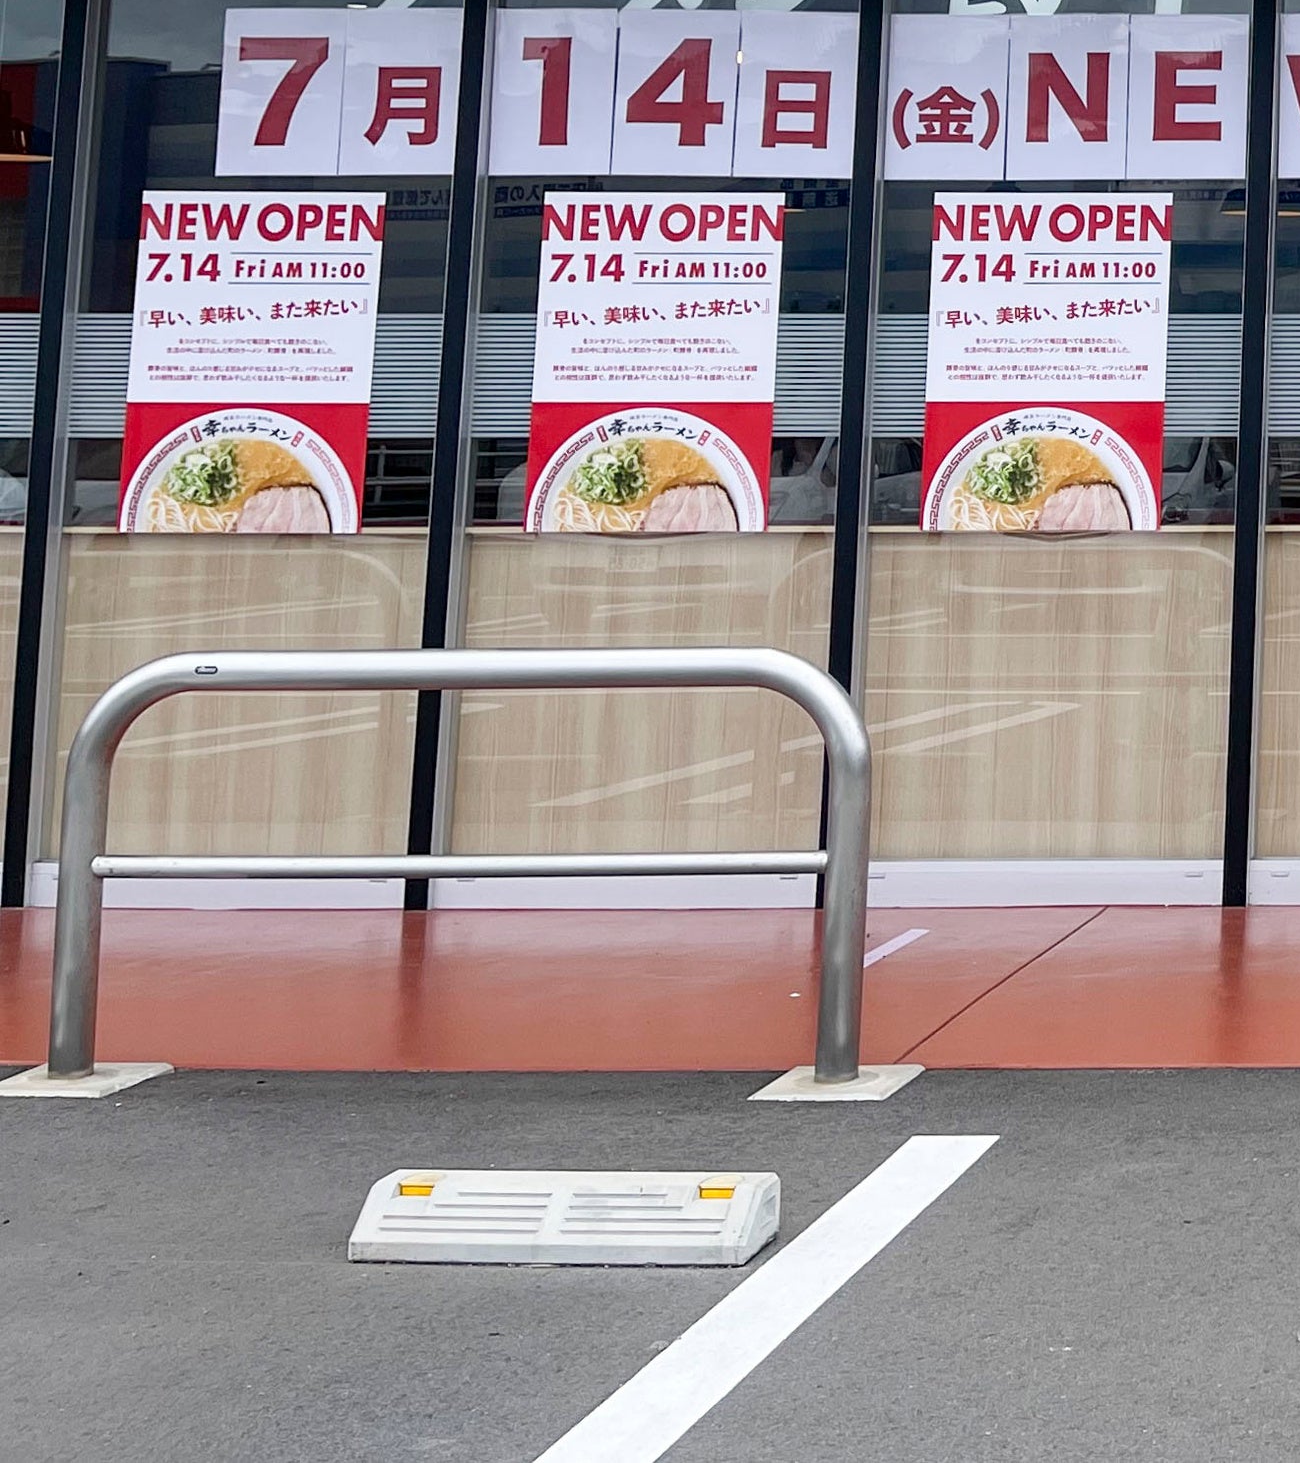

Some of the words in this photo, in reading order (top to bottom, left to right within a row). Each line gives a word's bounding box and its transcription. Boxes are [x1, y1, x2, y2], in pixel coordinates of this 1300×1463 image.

[140, 203, 251, 240] NEW
[257, 203, 385, 241] OPEN
[542, 204, 654, 241] NEW
[659, 204, 785, 241] OPEN
[932, 204, 1042, 241] NEW
[1049, 204, 1173, 241] OPEN
[145, 253, 221, 282] 7.14
[235, 259, 265, 278] Fri
[272, 261, 303, 278] AM
[310, 262, 366, 279] 11:00
[550, 254, 625, 282] 7.14
[639, 259, 669, 278] Fri
[676, 261, 706, 278] AM
[713, 261, 767, 278] 11:00
[940, 254, 1016, 282] 7.14
[1029, 259, 1059, 278] Fri
[1066, 261, 1096, 278] AM
[1103, 261, 1156, 279] 11:00
